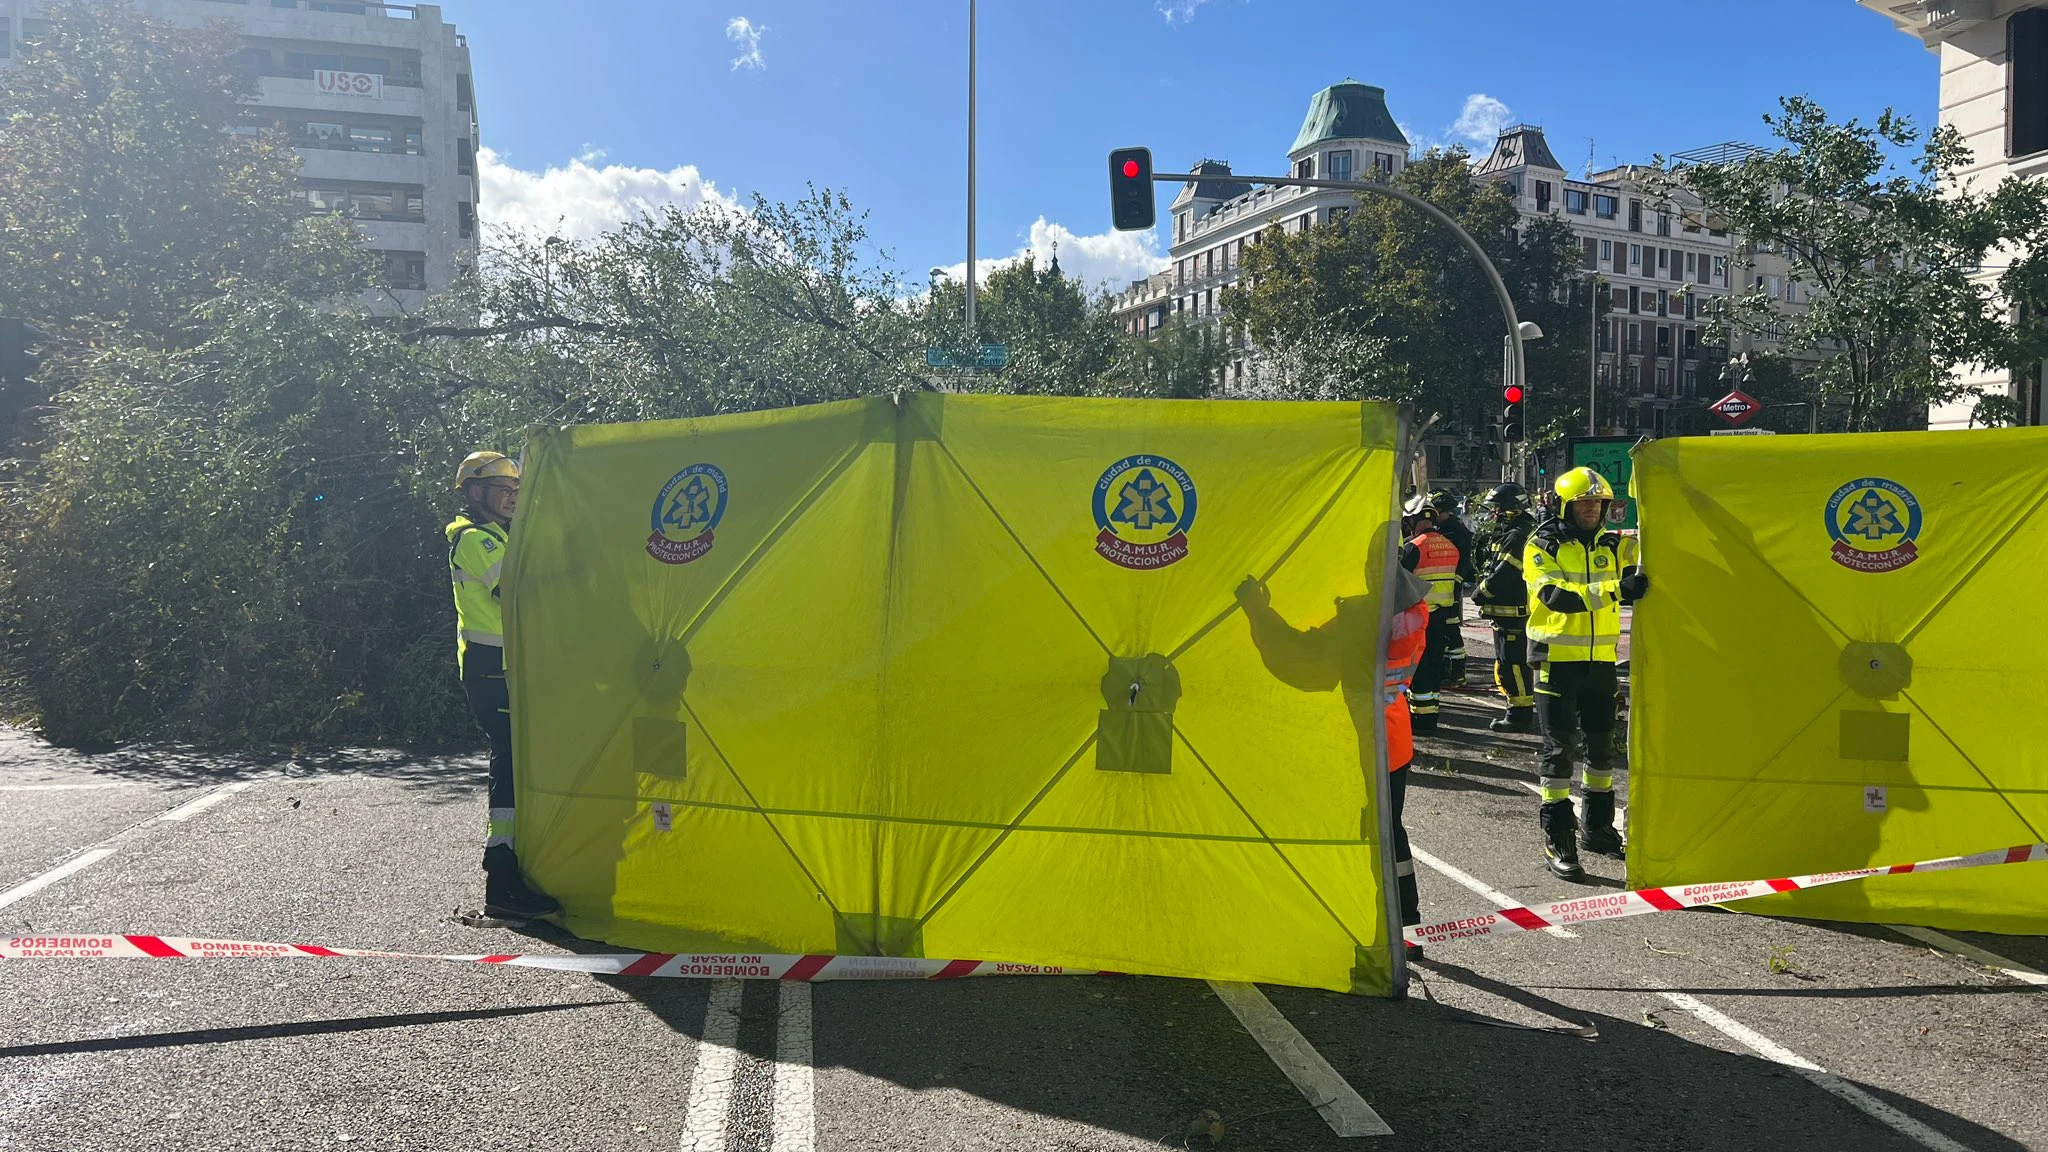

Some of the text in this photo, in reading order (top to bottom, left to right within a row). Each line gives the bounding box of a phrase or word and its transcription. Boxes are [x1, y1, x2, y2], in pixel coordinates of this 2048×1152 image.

[318, 72, 372, 93] USO
[661, 465, 727, 497] ciudad de madrid
[1100, 456, 1193, 492] ciudad de madrid
[1830, 479, 1916, 509] ciudad de madrid
[648, 541, 711, 560] PROTECCION CIVIL
[1098, 541, 1186, 566] PROTECCION CIVIL
[1834, 551, 1915, 570] PROTECCION CIVIL
[1693, 888, 1749, 904] NO PASAR
[1415, 915, 1496, 937] BOMBEROS
[1427, 927, 1492, 943] NO PASAR
[190, 942, 289, 952] BOMBEROS
[691, 955, 761, 964] NO PASAR
[996, 963, 1063, 974] NO PASAR
[680, 964, 770, 976] BOMBEROS
